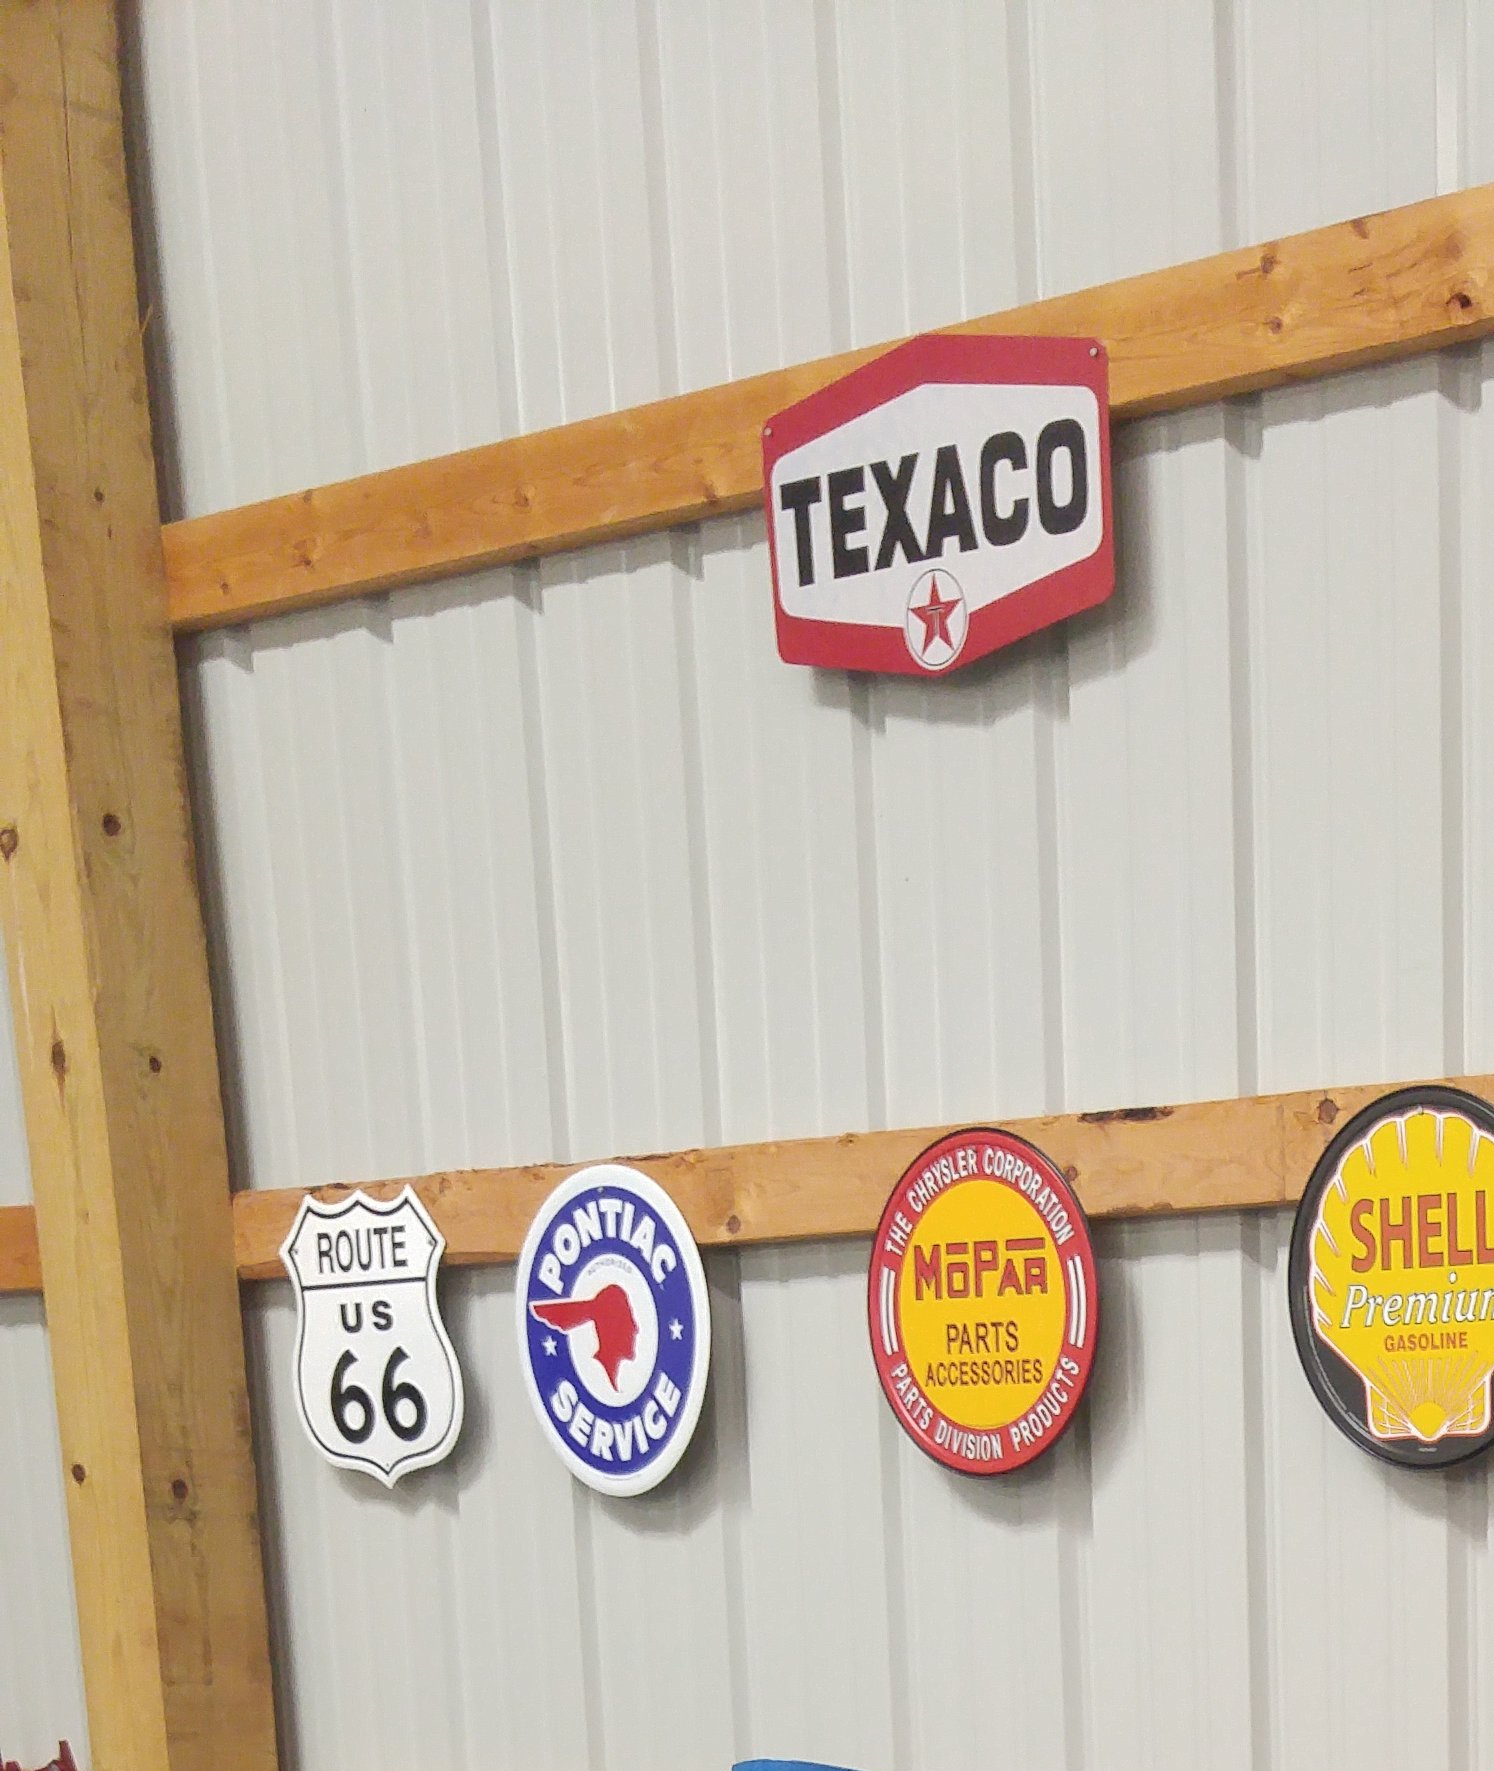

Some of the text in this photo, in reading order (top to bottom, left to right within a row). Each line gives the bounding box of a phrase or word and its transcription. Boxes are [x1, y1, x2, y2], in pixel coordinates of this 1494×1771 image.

[779, 418, 1089, 588] TEXACO
[538, 1198, 676, 1294] PONTIAC
[885, 1147, 1076, 1256] THE CHRYSLER CORPORATION
[317, 1224, 408, 1274] ROUTE
[925, 1358, 1043, 1388] ACCESSORIES
[946, 1320, 1019, 1354] PARTS
[1383, 1331, 1468, 1353] GASOLINE
[330, 1346, 428, 1445] 66
[552, 1371, 682, 1462] SERVICE
[891, 1356, 1081, 1462] PARTS DIVISION PRODUCTS
